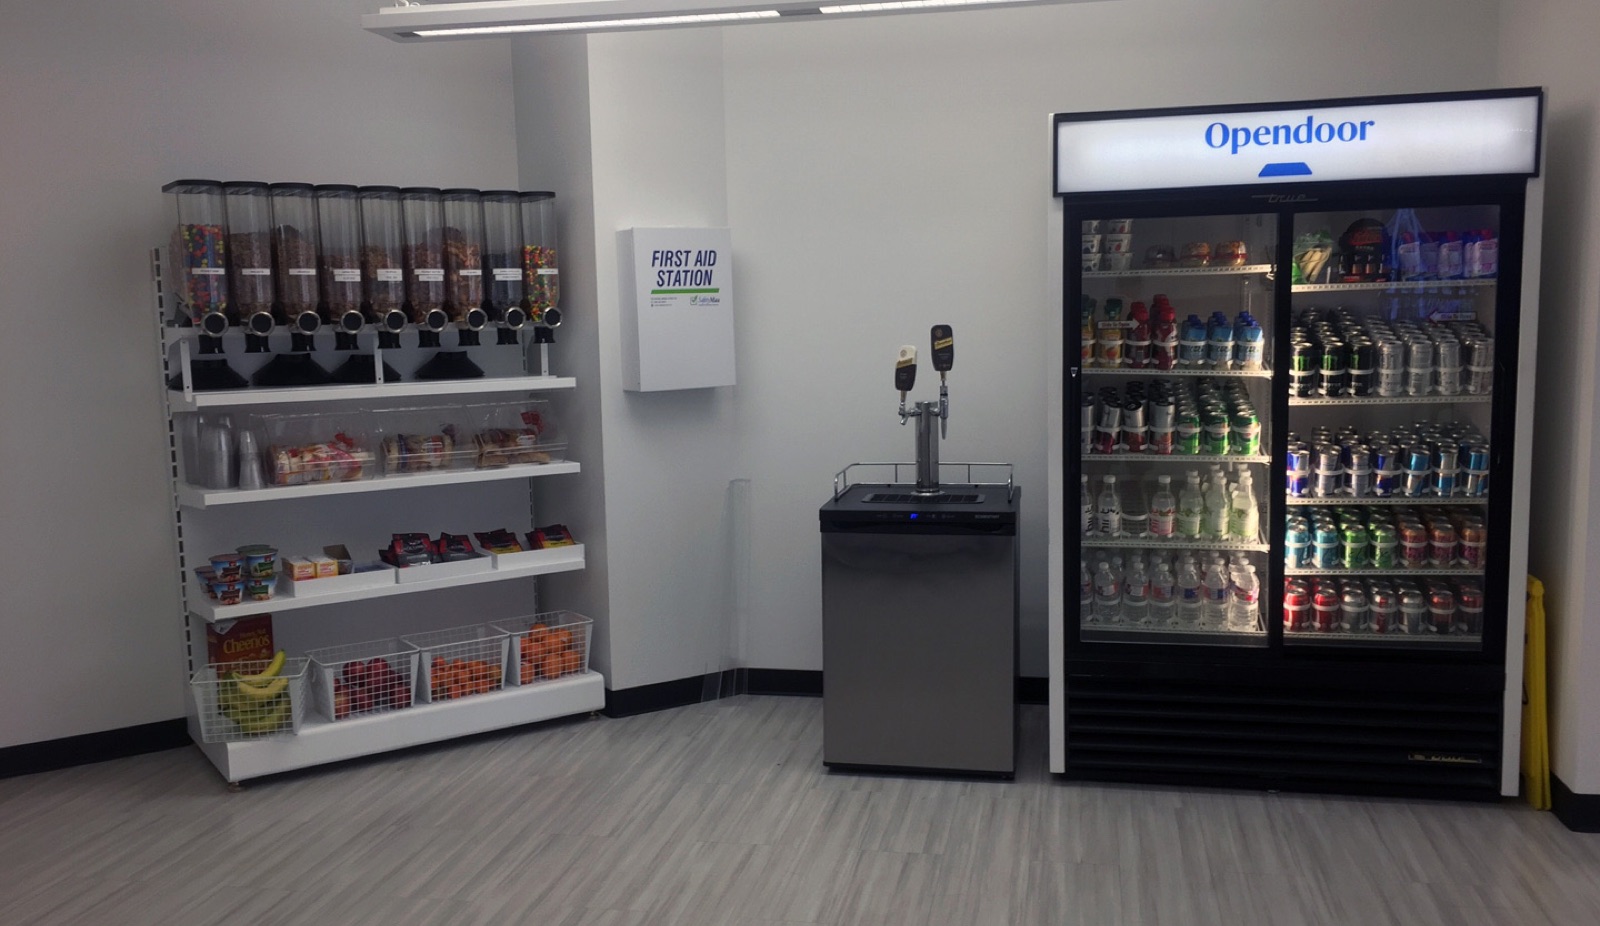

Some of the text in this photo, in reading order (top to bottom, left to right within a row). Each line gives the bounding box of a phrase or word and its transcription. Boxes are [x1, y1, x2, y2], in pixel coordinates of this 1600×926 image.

[1205, 115, 1375, 154] Opendoor
[651, 249, 717, 267] FIRST AID
[656, 269, 713, 287] STATION
[223, 635, 270, 654] Cheerios
